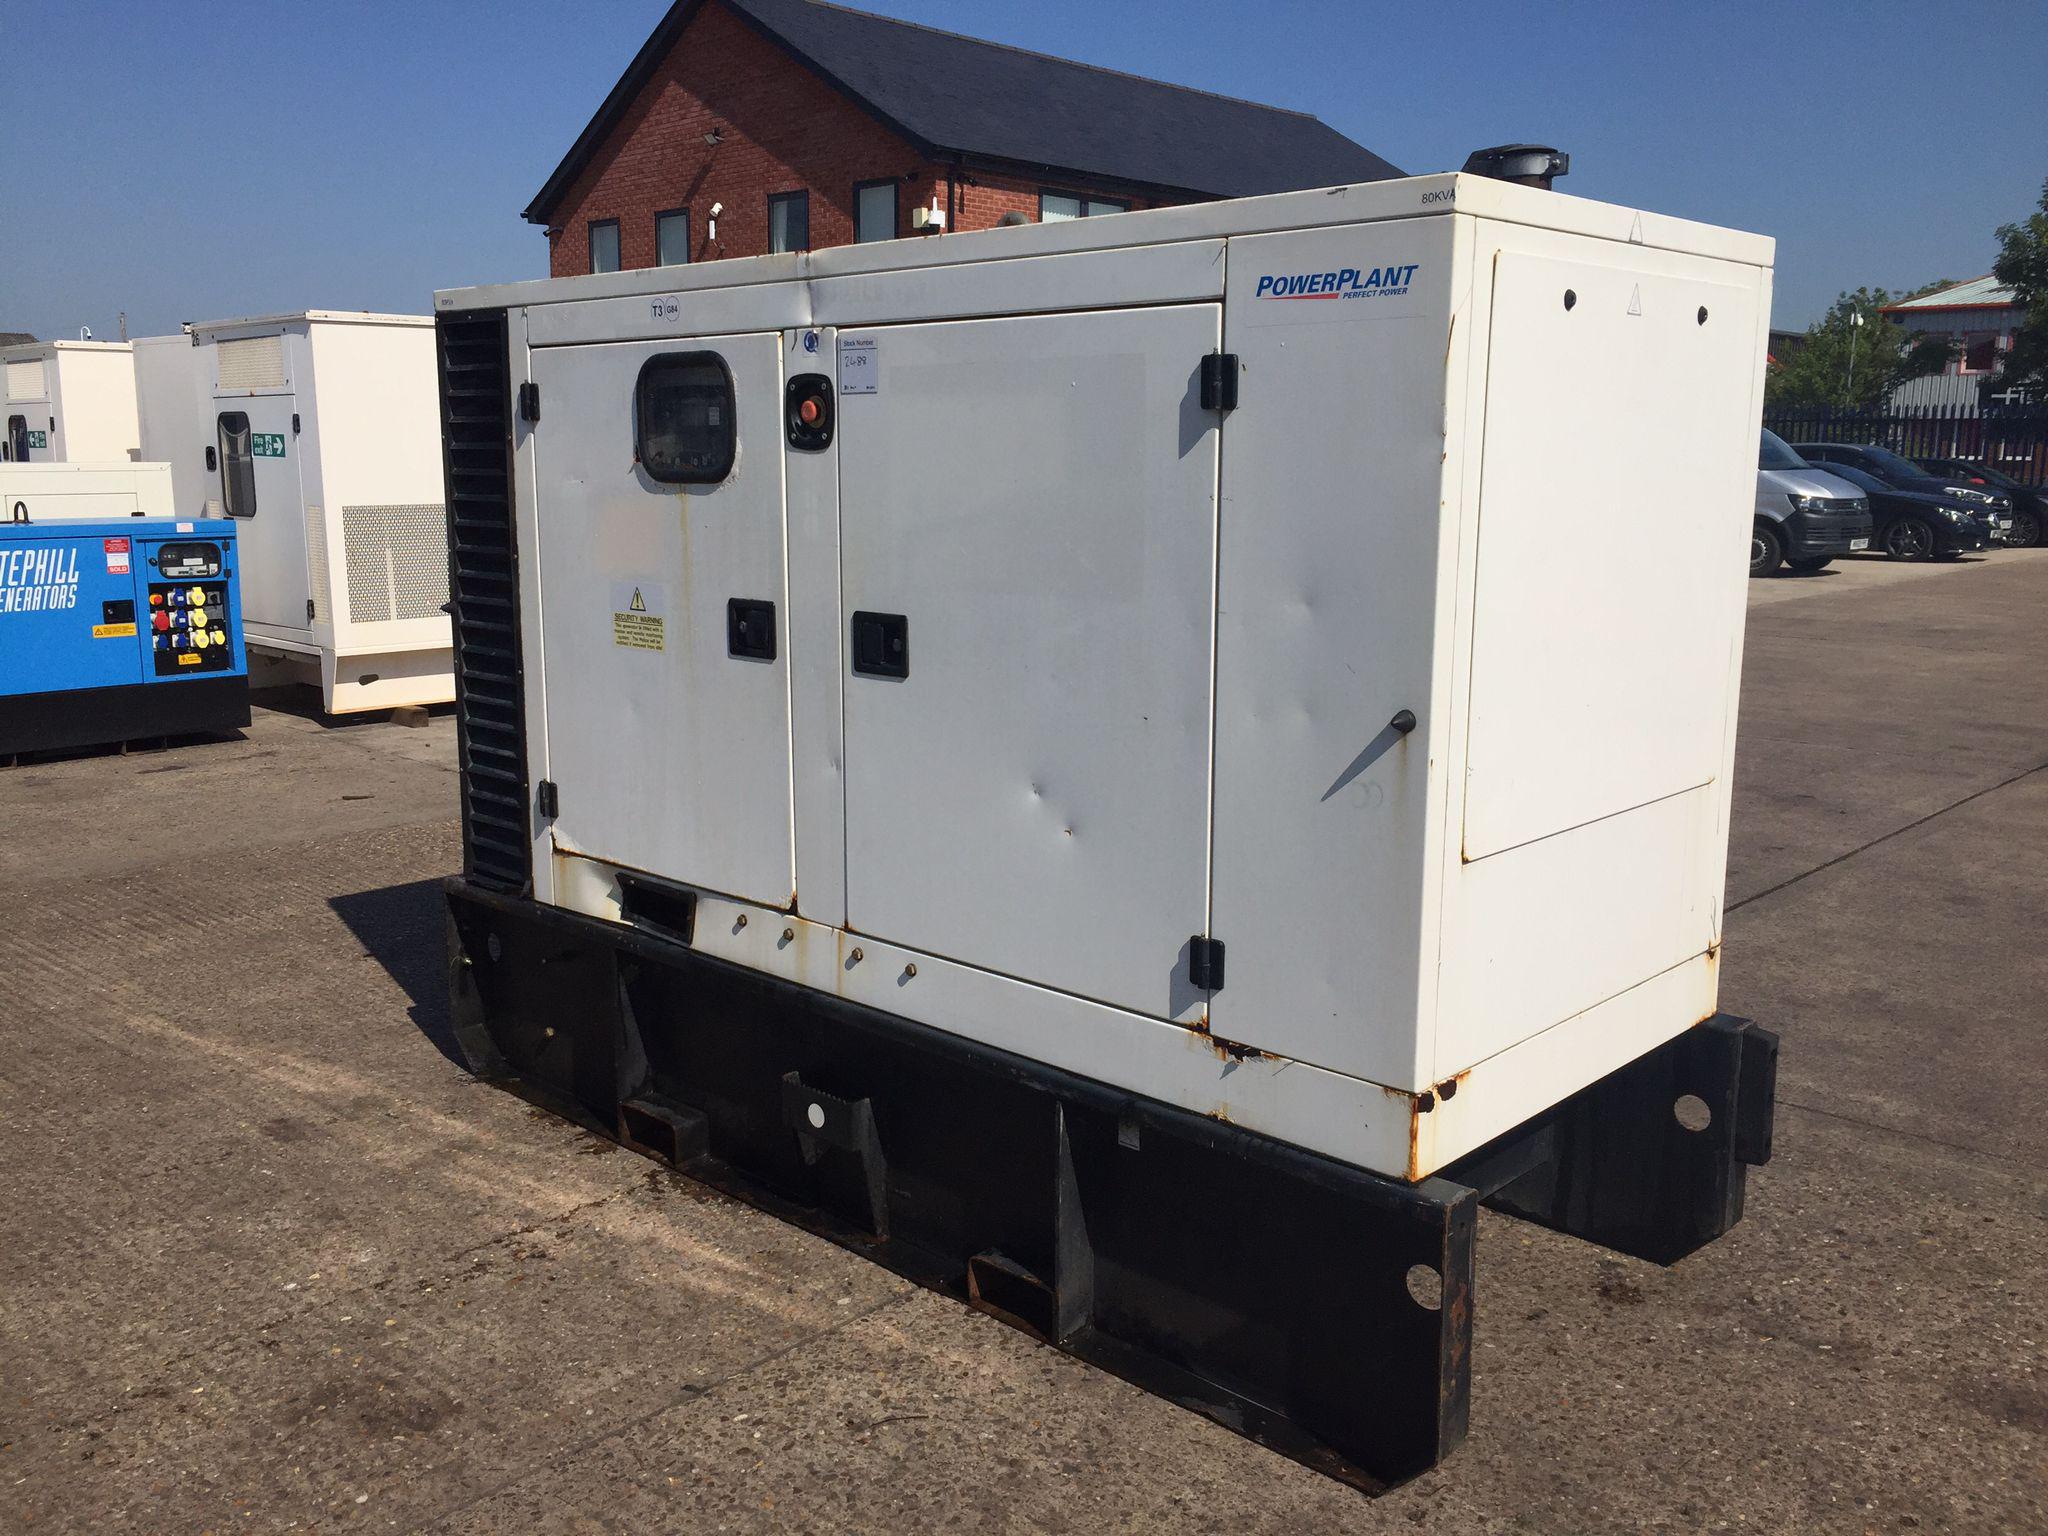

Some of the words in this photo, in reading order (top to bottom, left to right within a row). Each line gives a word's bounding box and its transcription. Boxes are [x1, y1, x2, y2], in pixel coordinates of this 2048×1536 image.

[1421, 188, 1456, 204] 80KVA
[1256, 264, 1420, 298] POWERPLANT
[1342, 289, 1377, 300] PERFECT
[1378, 287, 1409, 297] POWER
[652, 304, 663, 318] T3
[109, 566, 128, 574] SOLD
[614, 613, 638, 622] SECURITY
[640, 616, 663, 625] WARNING
